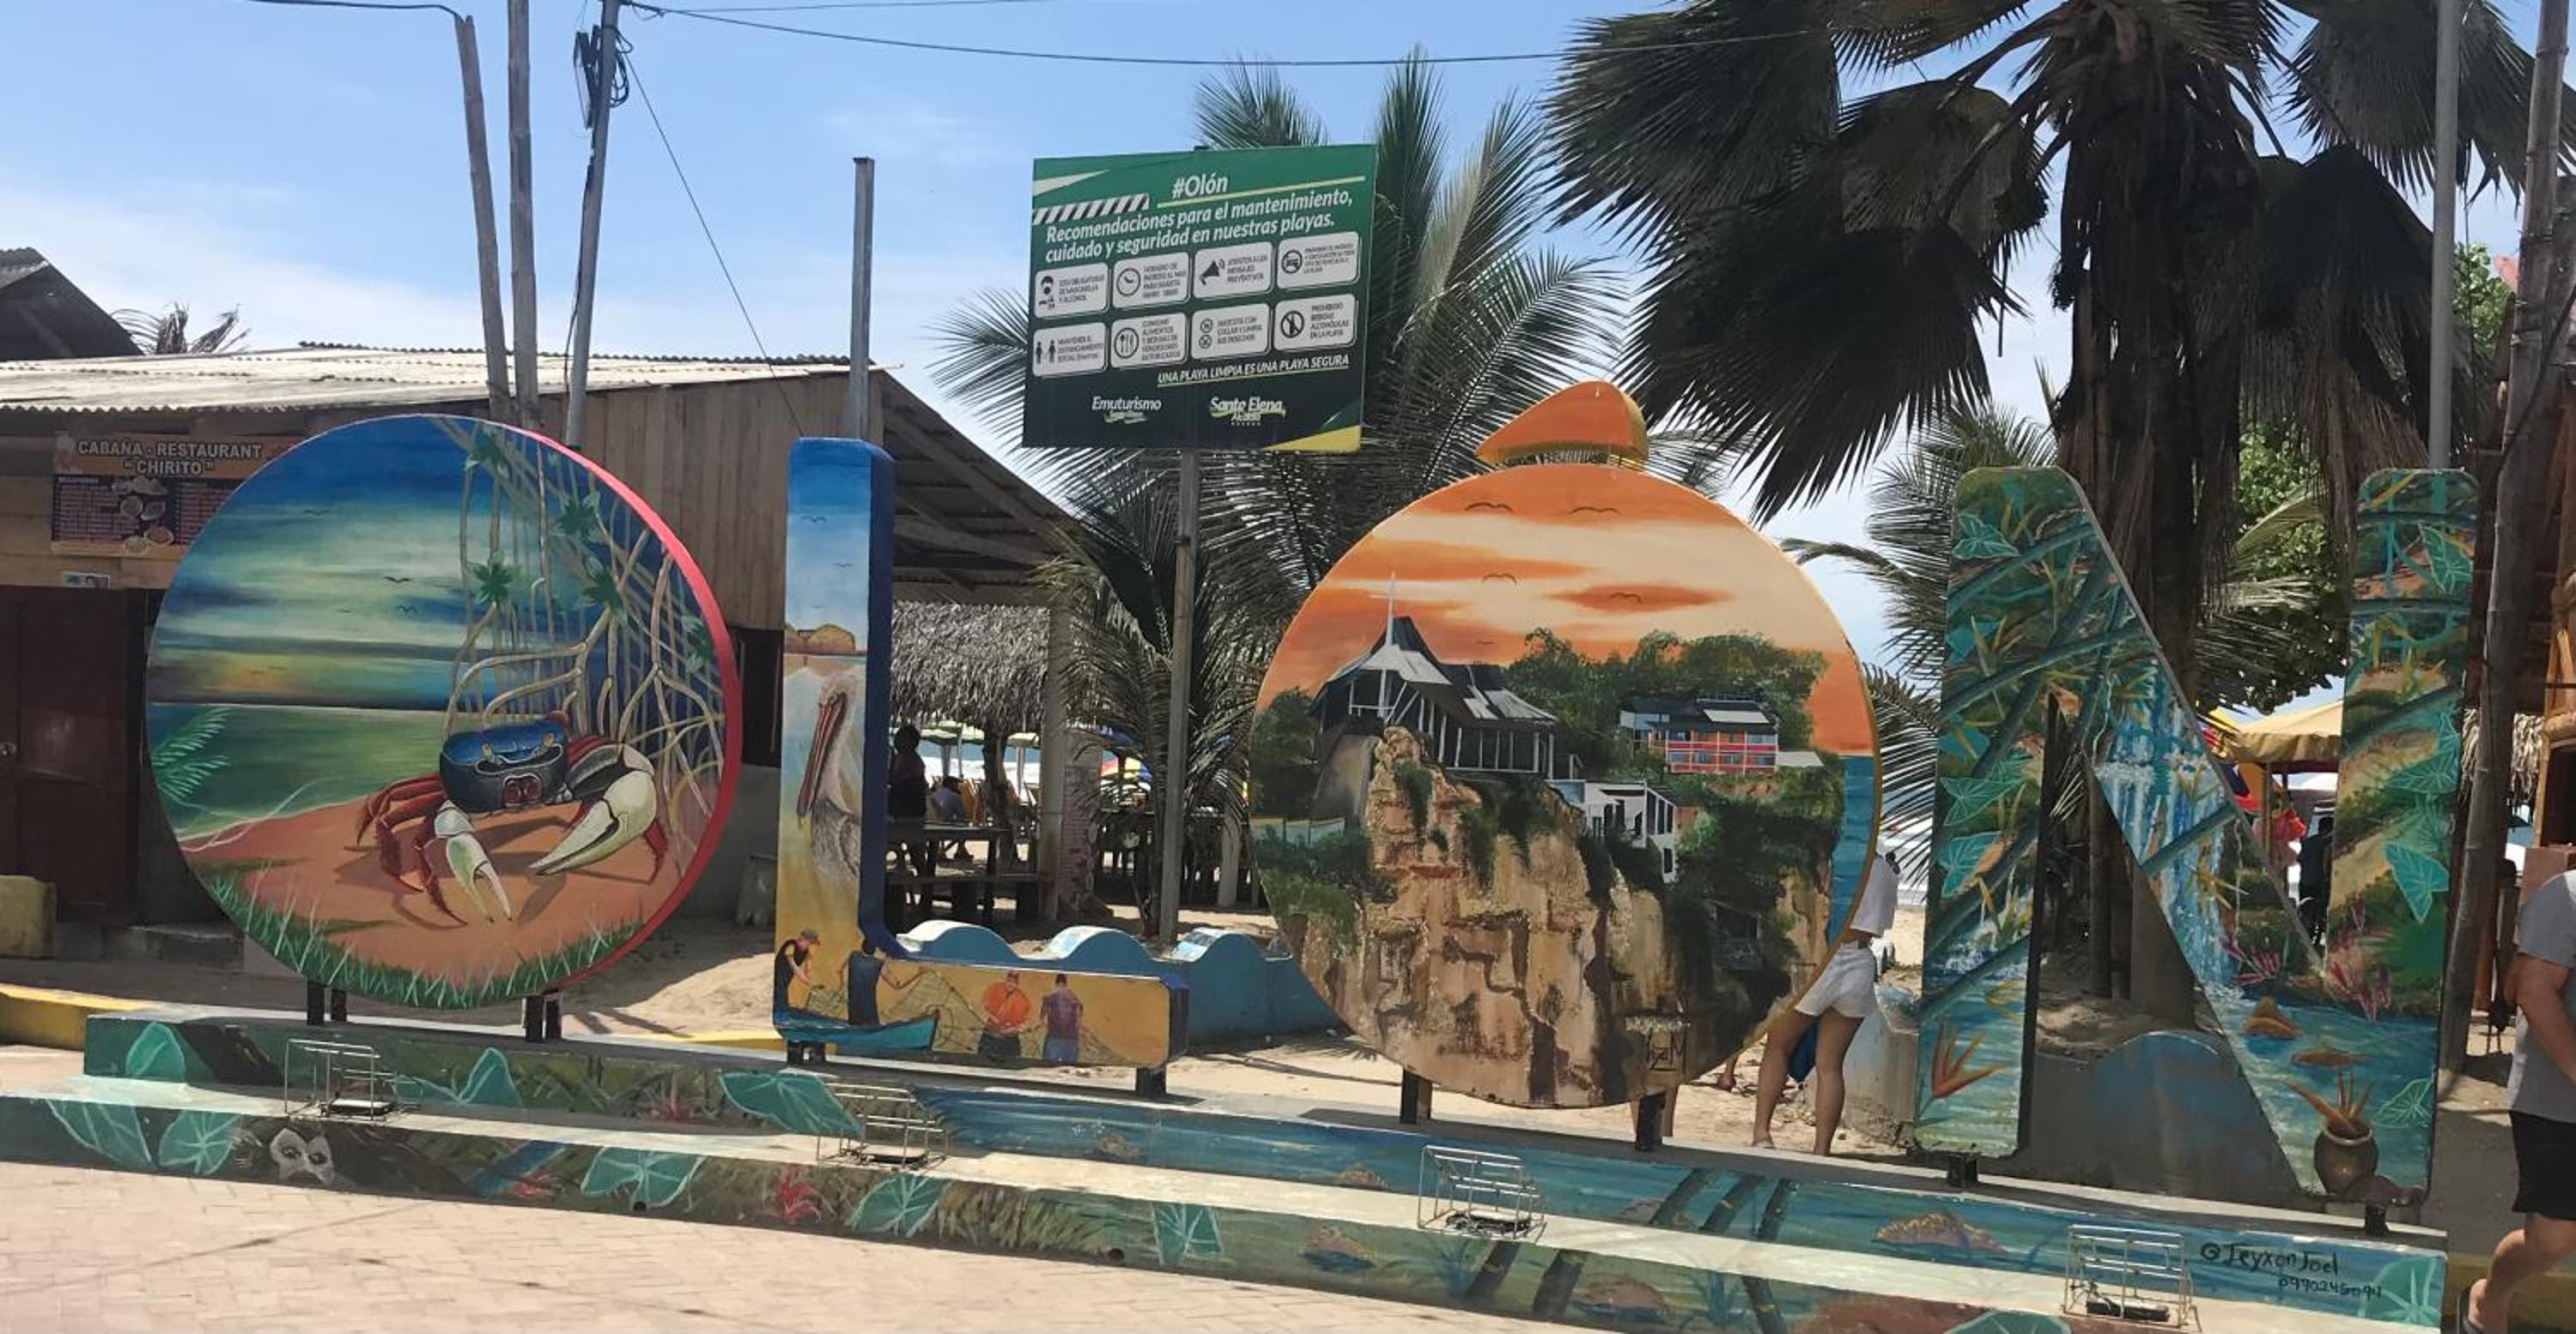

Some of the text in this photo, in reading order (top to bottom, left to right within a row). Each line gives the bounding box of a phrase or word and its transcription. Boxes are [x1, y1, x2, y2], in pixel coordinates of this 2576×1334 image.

[1172, 173, 1229, 199] #Olón
[1046, 188, 1353, 244] Recomendaciones para el mantenimiento,
[1045, 213, 1335, 264] cuidado y seguridad en nuestras playas.
[1157, 354, 1350, 384] UNA PLAYA LIMPIA ES UNA PLAYA SEGURA
[1091, 396, 1162, 410] Emuturismo
[78, 440, 143, 456] CABAÑA
[156, 443, 261, 459] RESTAURANT
